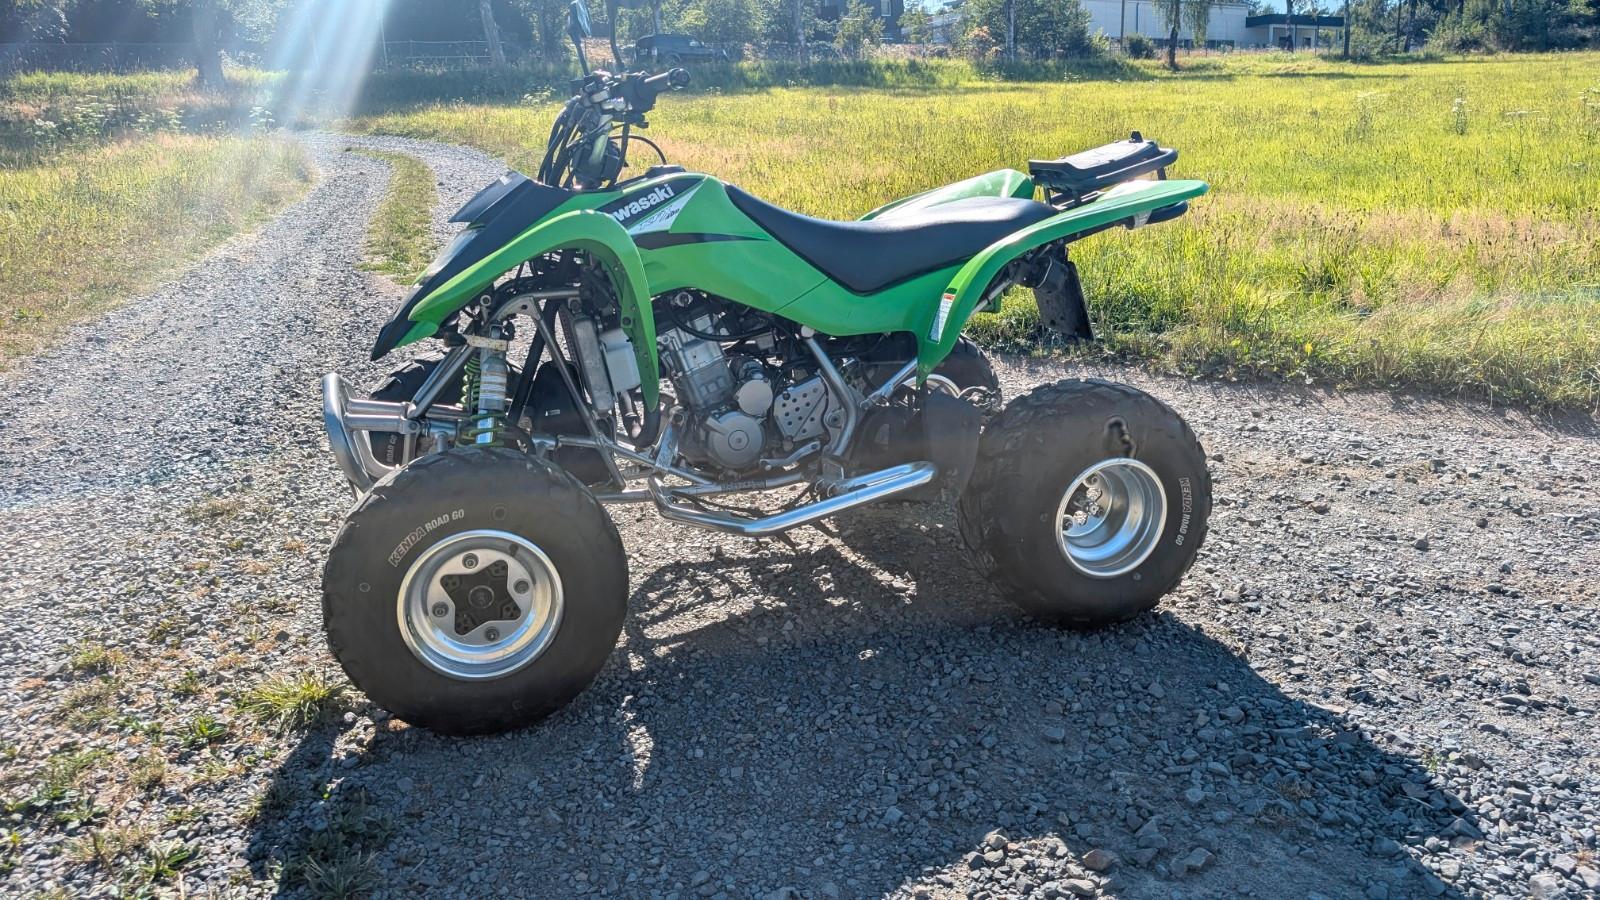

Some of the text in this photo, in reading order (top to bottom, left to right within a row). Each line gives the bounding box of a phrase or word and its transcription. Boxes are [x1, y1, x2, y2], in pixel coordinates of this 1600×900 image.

[613, 184, 675, 222] wasaki
[387, 508, 465, 568] KENDA ROAD GO
[1175, 477, 1192, 546] KENDA ROAD GO
